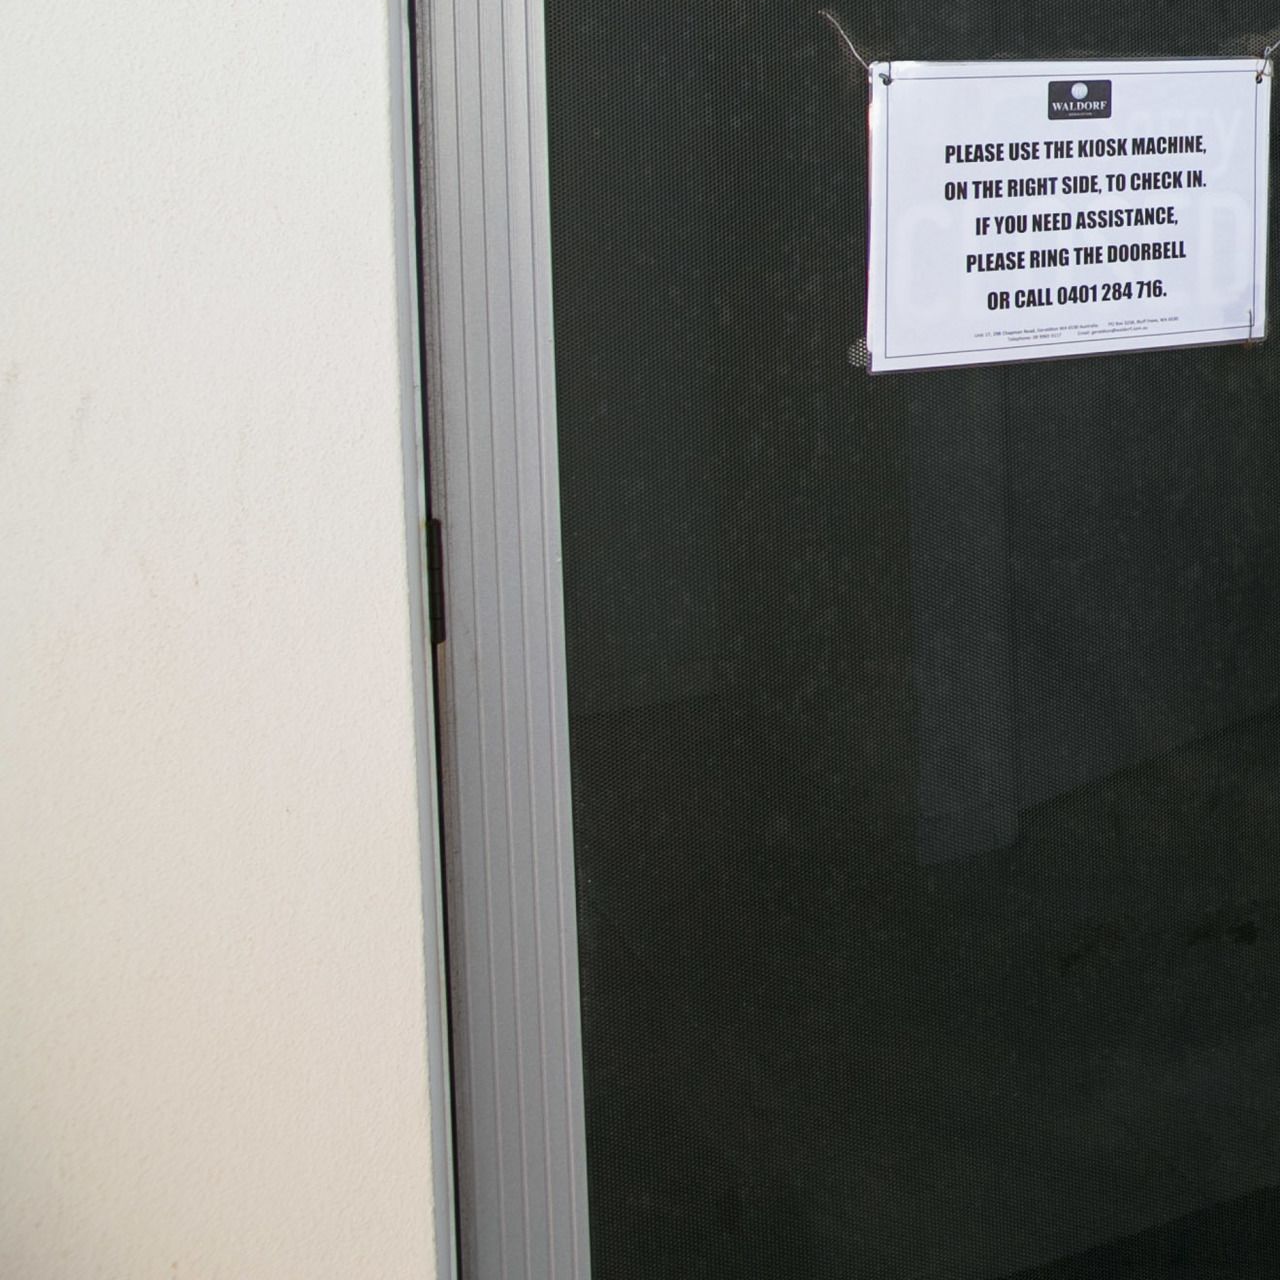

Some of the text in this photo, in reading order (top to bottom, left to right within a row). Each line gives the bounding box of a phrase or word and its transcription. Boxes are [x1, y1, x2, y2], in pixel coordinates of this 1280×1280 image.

[1052, 101, 1107, 111] WALDORF
[945, 135, 1207, 164] PLEASE USE THE KIOSK MACHINE,
[945, 170, 1207, 201] ON THE RIGHT SIDE, TO CHECK IN.
[975, 207, 1179, 235] IF YOU NEED ASSISTANCE,
[966, 241, 1186, 273] PLEASE RING THE DOORBELL
[988, 280, 1167, 310] OR CALL 0401 284 716.
